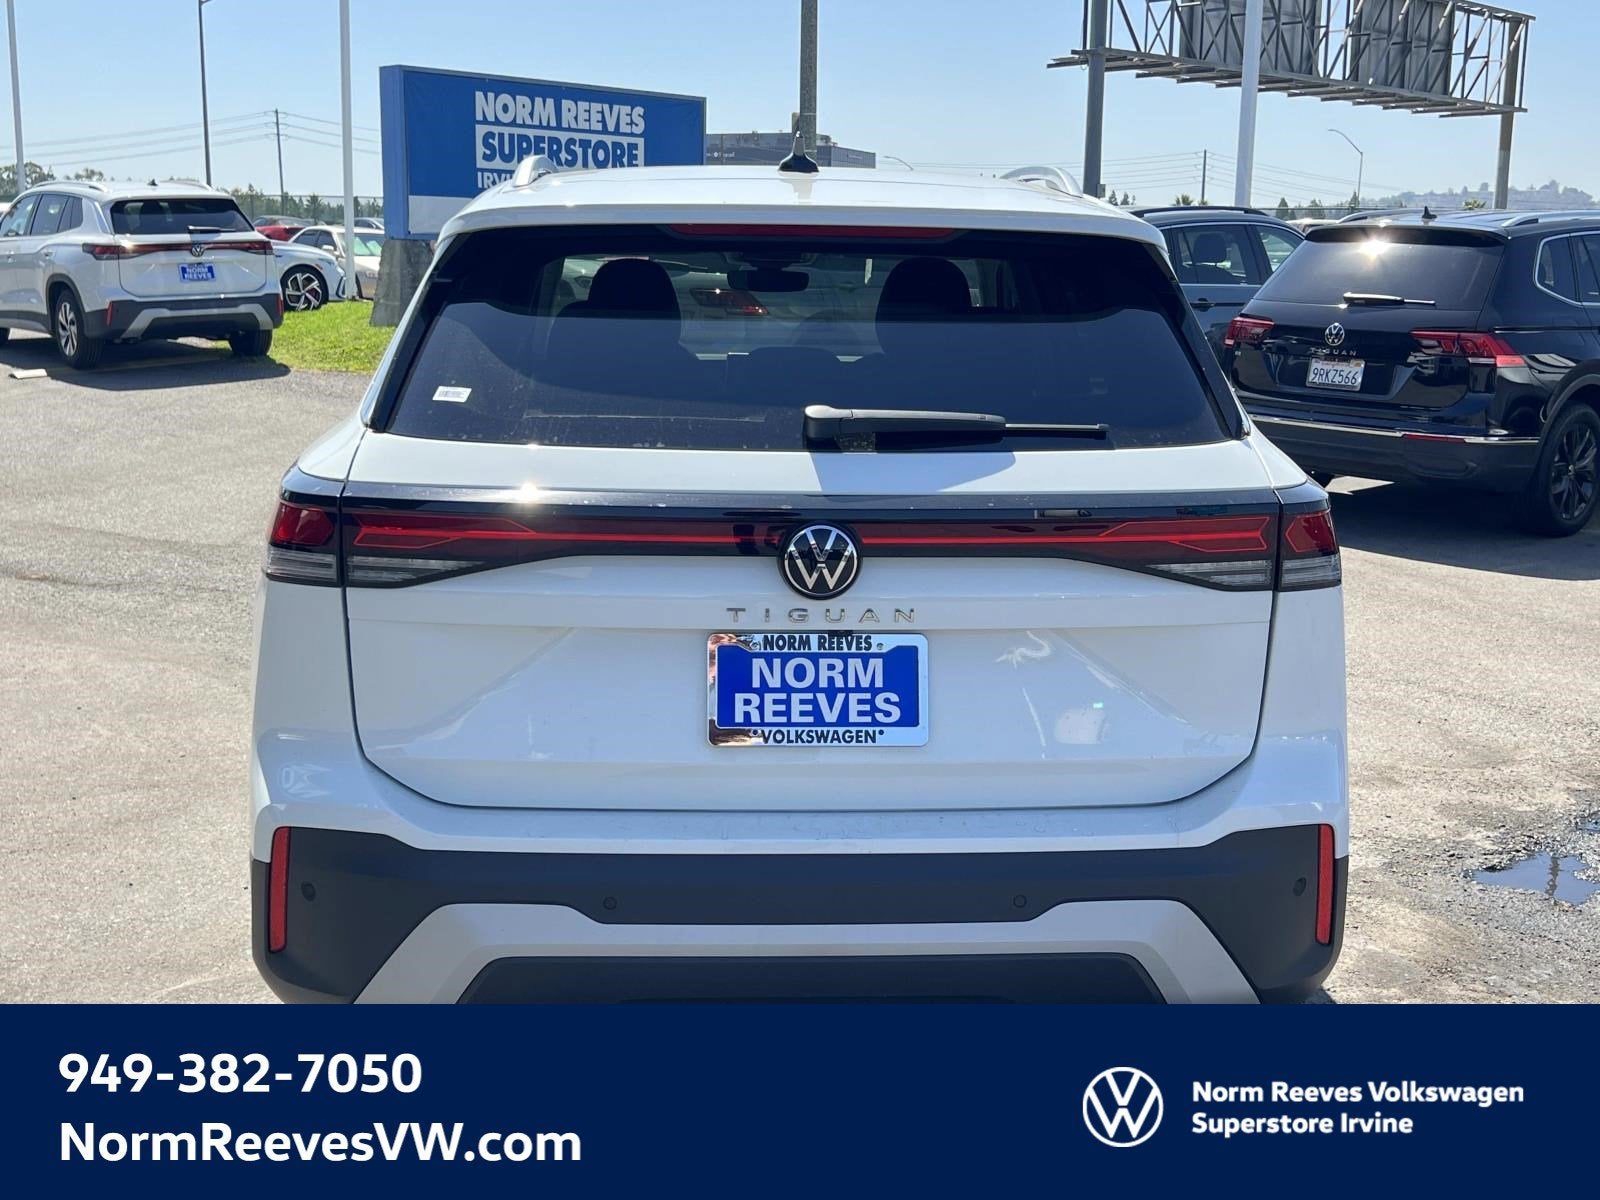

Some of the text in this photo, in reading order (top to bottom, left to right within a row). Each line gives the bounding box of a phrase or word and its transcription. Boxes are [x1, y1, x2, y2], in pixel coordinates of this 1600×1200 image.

[475, 91, 645, 135] NORM REEVES
[482, 130, 639, 169] SUPERSTORE
[1312, 367, 1359, 385] 9RKZ566
[726, 607, 916, 623] TIGUAN
[763, 634, 872, 651] NORM REEVES
[752, 657, 883, 689] NORM
[734, 691, 902, 724] REEVES
[761, 729, 877, 744] VOLKSWAGEN
